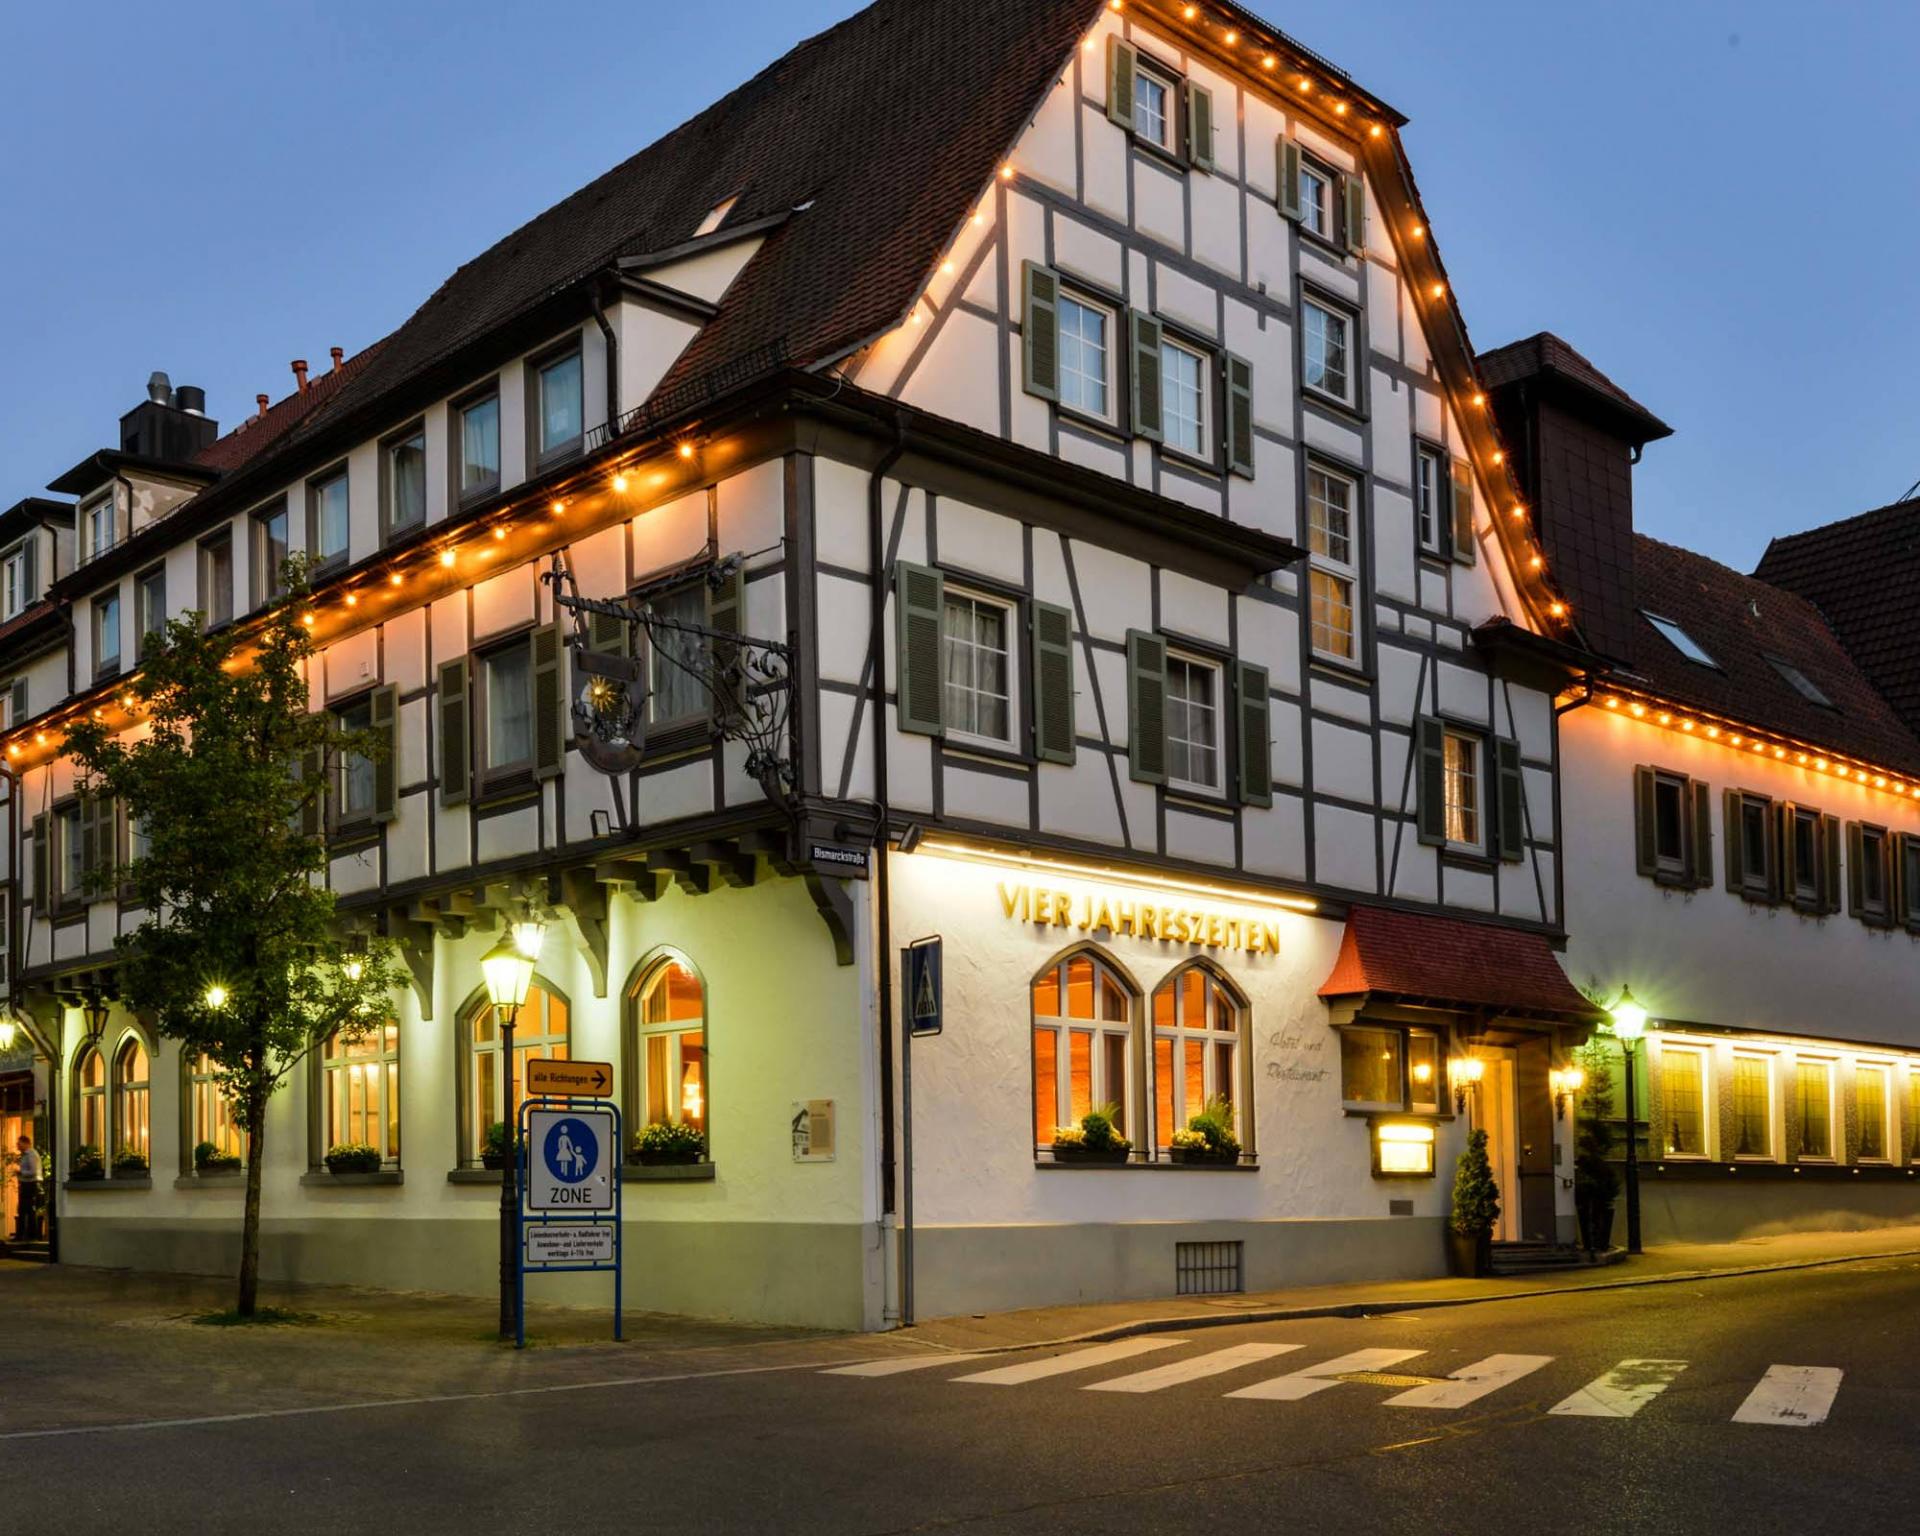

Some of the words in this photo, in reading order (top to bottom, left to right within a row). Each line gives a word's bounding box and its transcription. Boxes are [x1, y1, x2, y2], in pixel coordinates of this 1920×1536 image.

[813, 847, 866, 865] Bismarckstraße
[997, 881, 1073, 929] VIER
[1078, 896, 1281, 955] JAHRESZEITEN
[1304, 1037, 1326, 1052] und
[534, 1072, 548, 1082] alle
[549, 1072, 588, 1086] Richtungen
[1266, 1061, 1329, 1082] Restaurant
[551, 1187, 592, 1204] ZONE
